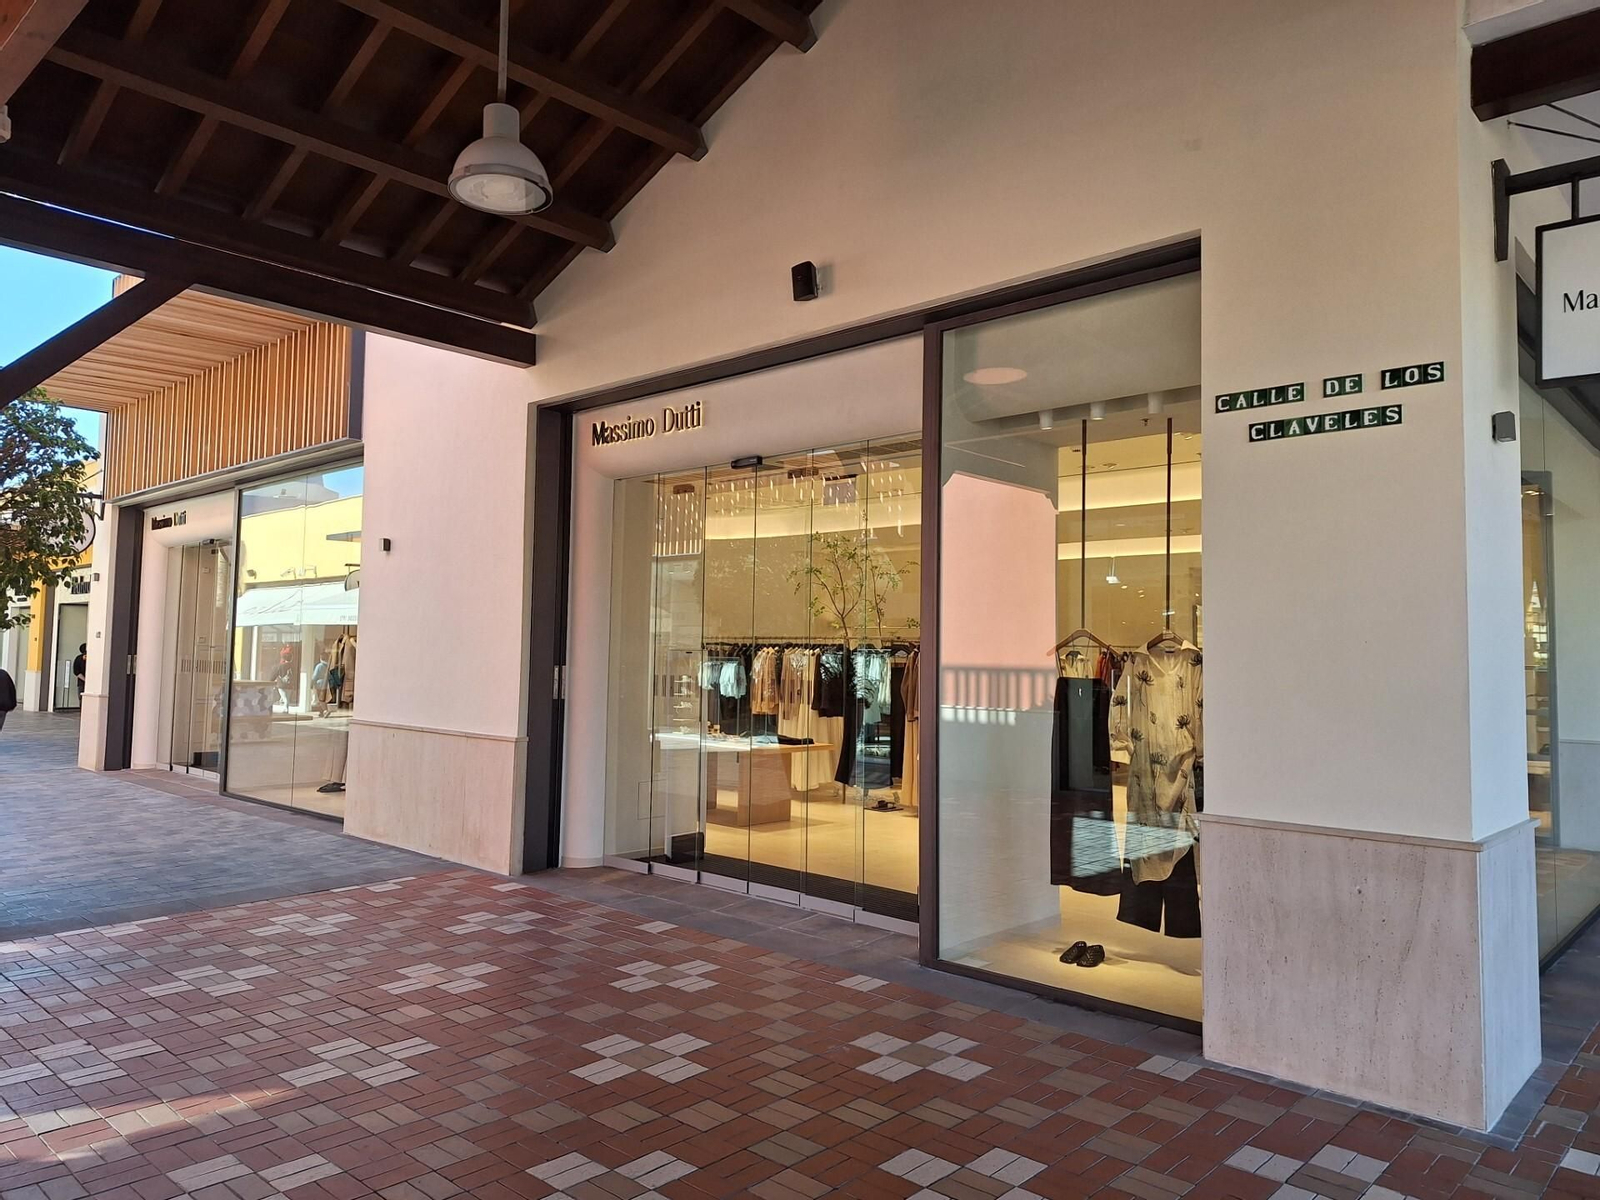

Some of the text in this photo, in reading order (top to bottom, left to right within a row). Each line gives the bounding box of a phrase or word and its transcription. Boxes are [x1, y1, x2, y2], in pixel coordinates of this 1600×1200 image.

[1216, 363, 1443, 411] CALLE DE LOS
[592, 401, 701, 446] Massimo Dutti
[1250, 406, 1400, 440] CLAVELES
